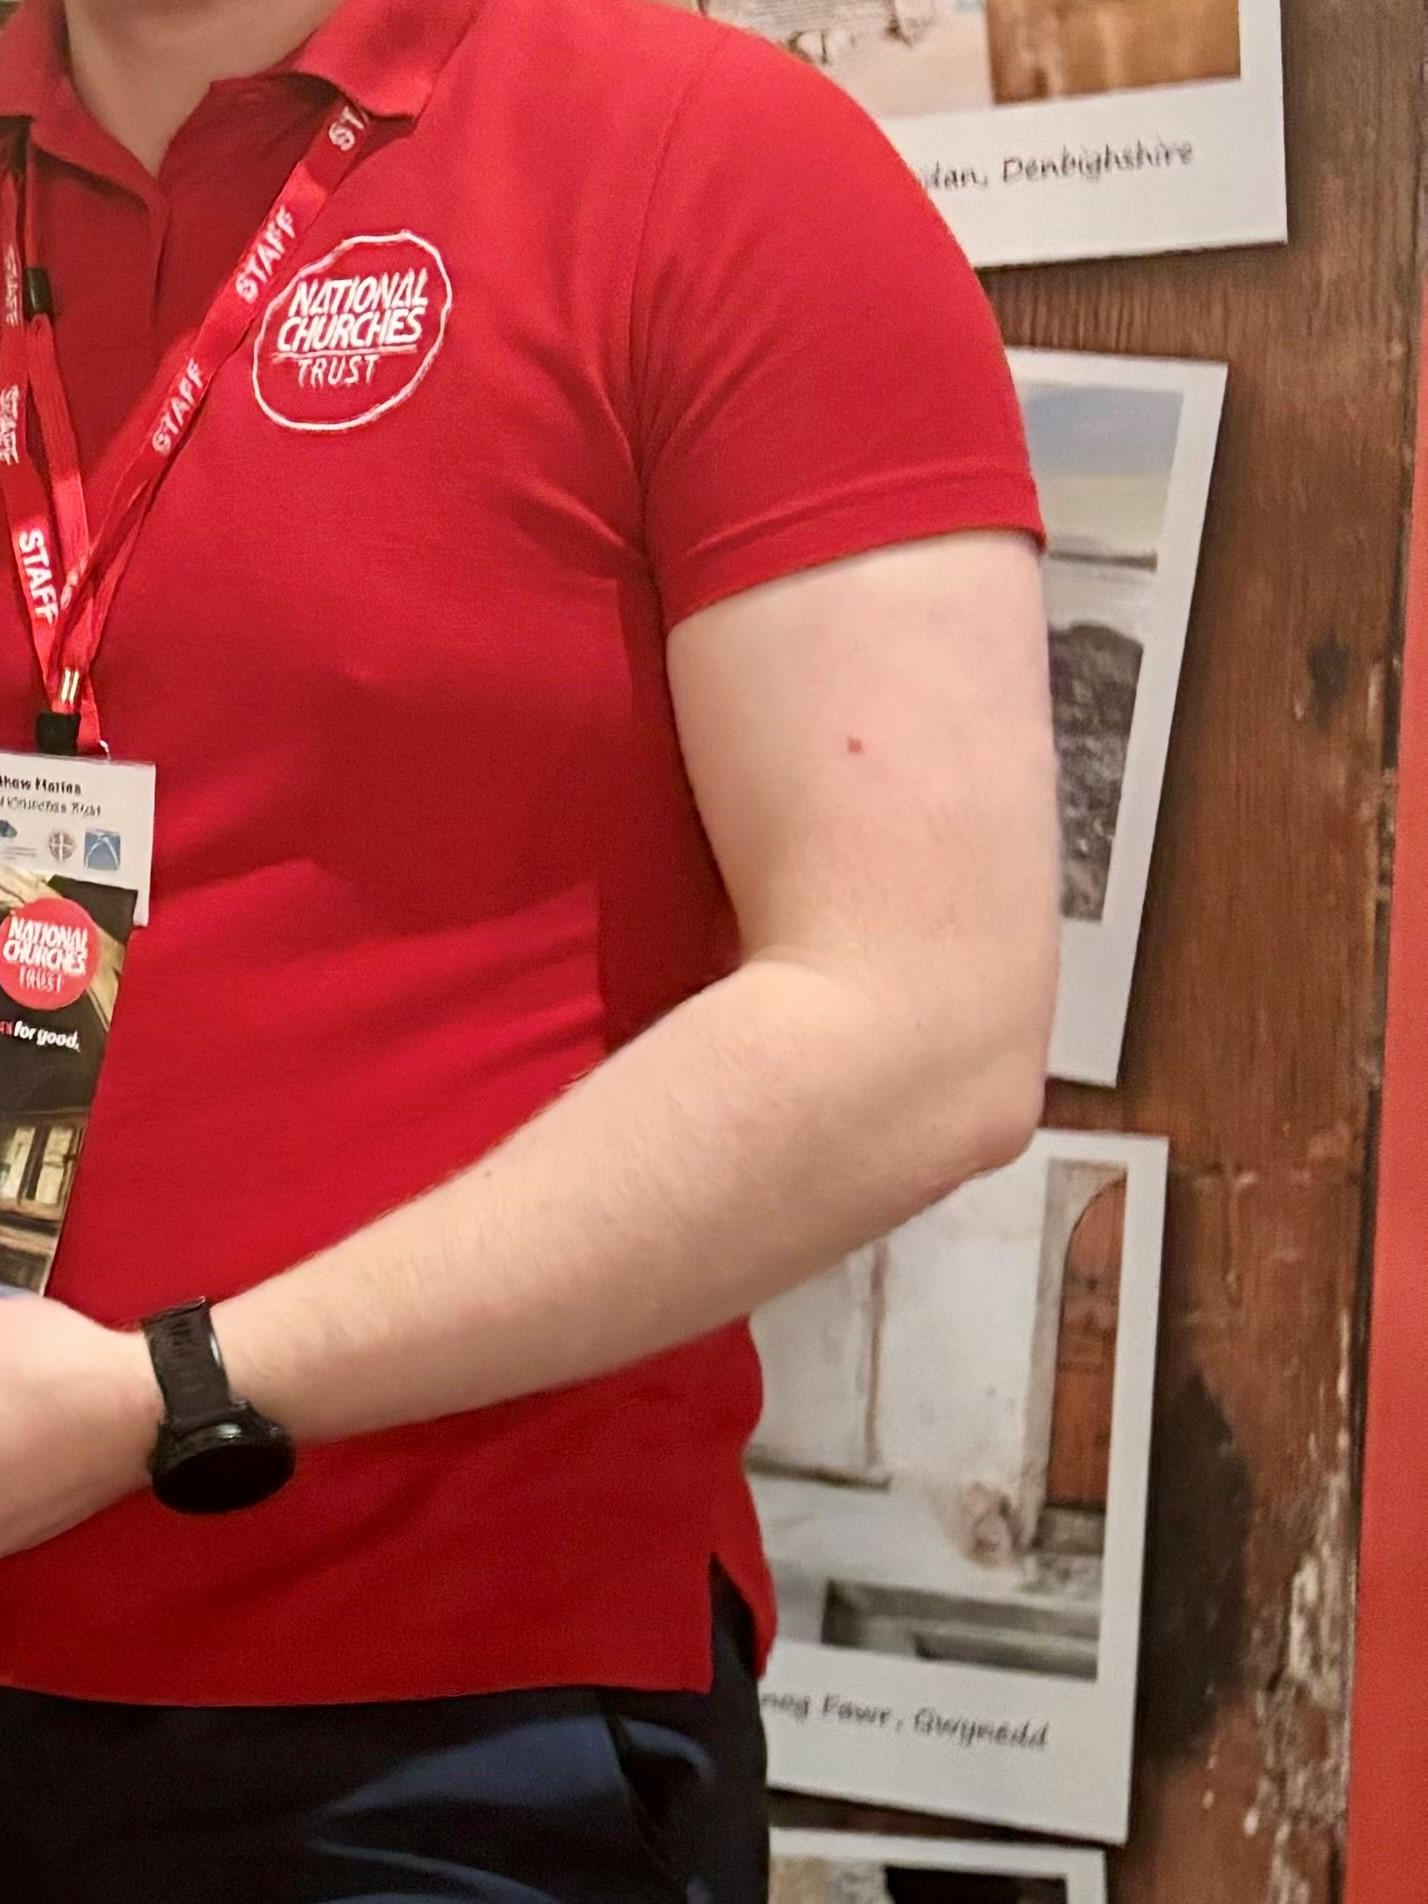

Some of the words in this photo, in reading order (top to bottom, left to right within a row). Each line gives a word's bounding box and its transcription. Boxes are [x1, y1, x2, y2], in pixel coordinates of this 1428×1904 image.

[1002, 139, 1194, 183] Denbighshire
[235, 204, 297, 303] STAFF
[288, 267, 429, 318] NATIONAL
[276, 307, 428, 353] CHURCHES
[296, 353, 380, 388] TRUST
[151, 356, 207, 456] STAFF
[17, 528, 61, 625] STAFF
[7, 915, 89, 949] NATIONAL
[1, 938, 89, 976] CHURCHES
[13, 1020, 36, 1040] for
[36, 1030, 81, 1052] good.
[913, 1706, 1049, 1748] Gwynedd
